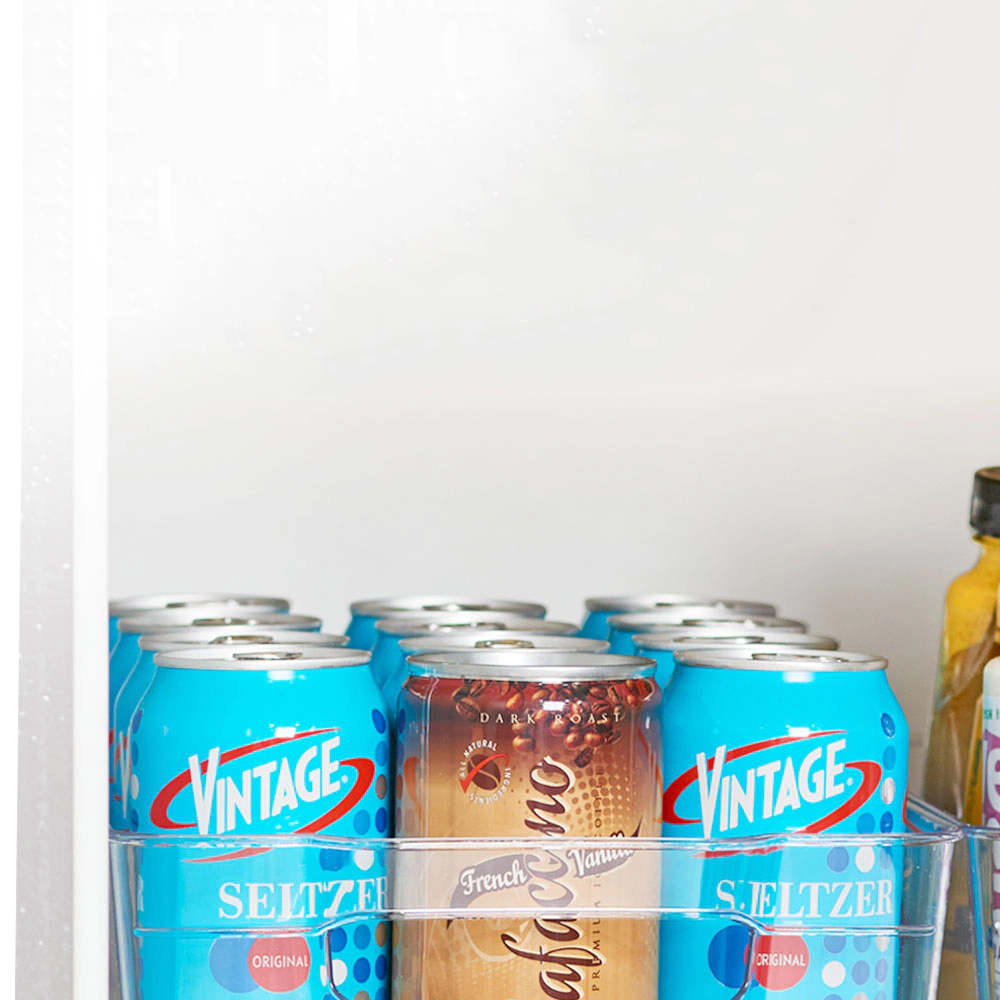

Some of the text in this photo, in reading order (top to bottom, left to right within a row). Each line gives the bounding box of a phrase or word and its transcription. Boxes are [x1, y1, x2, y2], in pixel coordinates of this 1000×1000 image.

[480, 711, 622, 725] DARK ROAST
[463, 739, 498, 758] NATURAL
[188, 735, 341, 836] VINTAGE
[695, 738, 847, 839] VINTAGE
[460, 858, 528, 896] French
[218, 876, 388, 919] SELTZER
[251, 955, 309, 969] ORIGINAL
[756, 953, 806, 966] ORIGINAL
